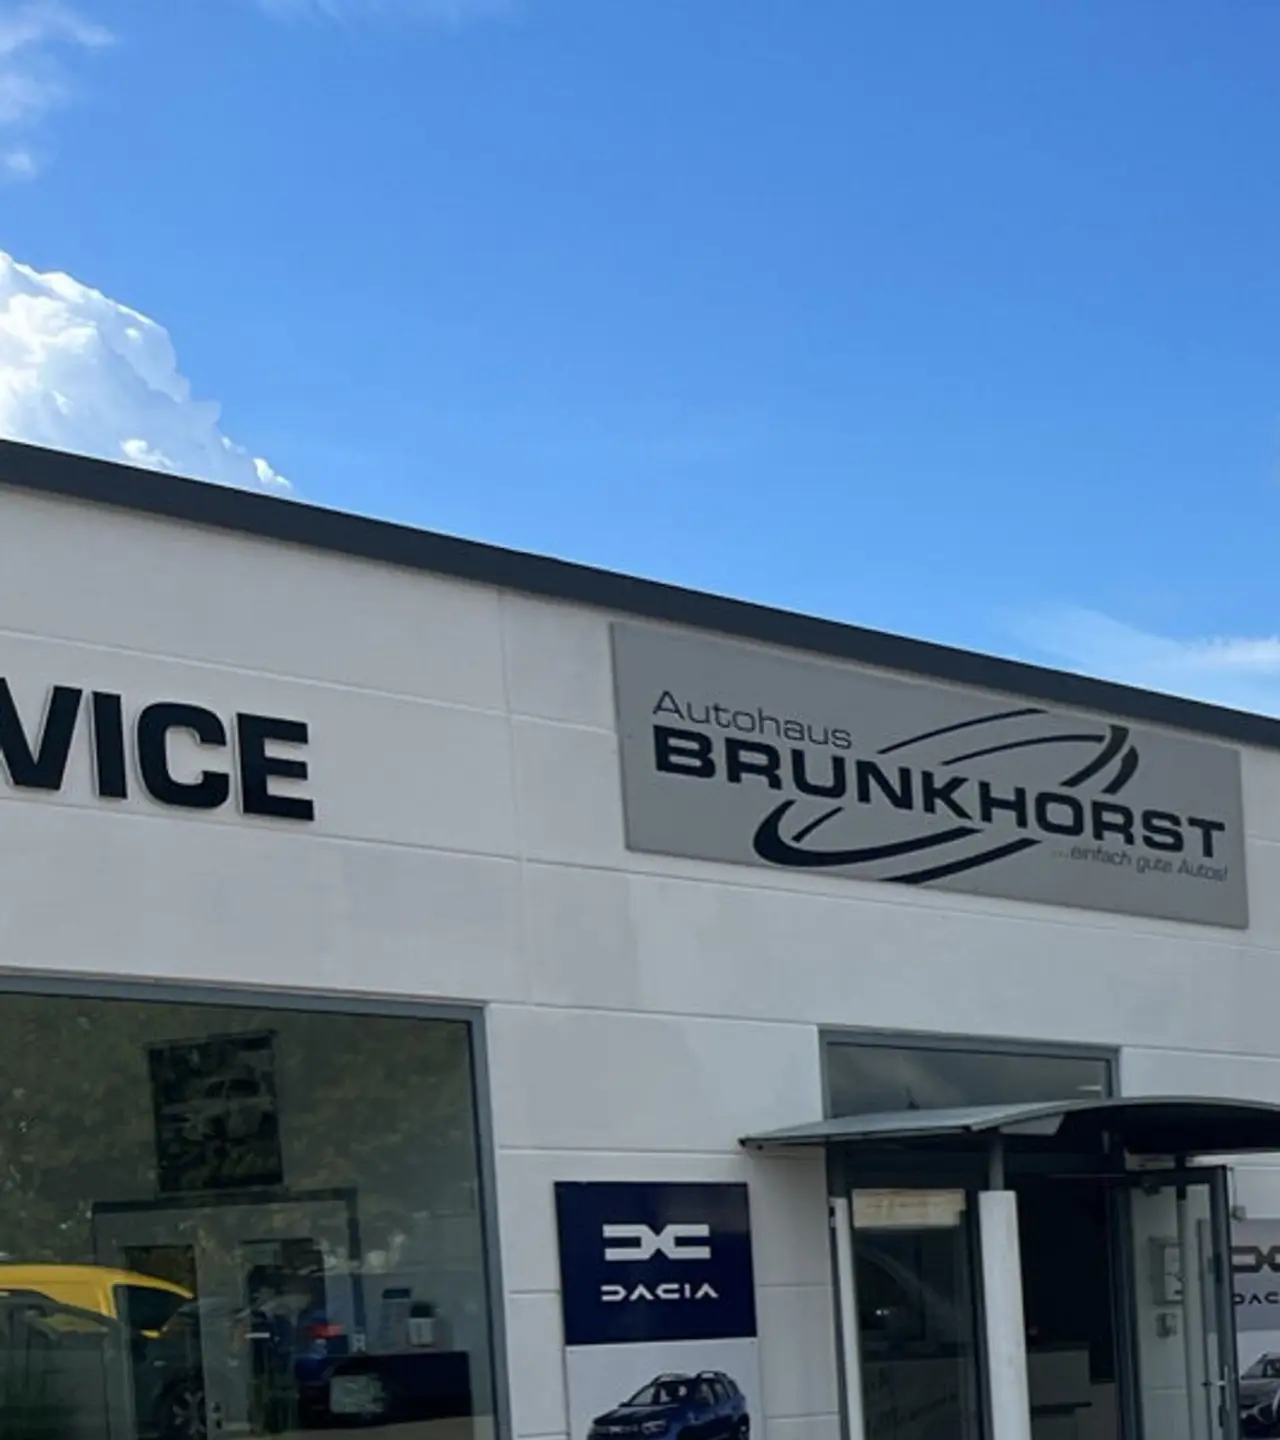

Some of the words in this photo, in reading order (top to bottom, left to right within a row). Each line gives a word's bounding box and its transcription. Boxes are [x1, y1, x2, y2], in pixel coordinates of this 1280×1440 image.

[652, 690, 853, 750] Autohaus
[652, 724, 1226, 858] BRUNKHORST
[1136, 856, 1172, 874] gute
[1177, 858, 1228, 881] Autos!
[600, 1282, 719, 1301] DACIA
